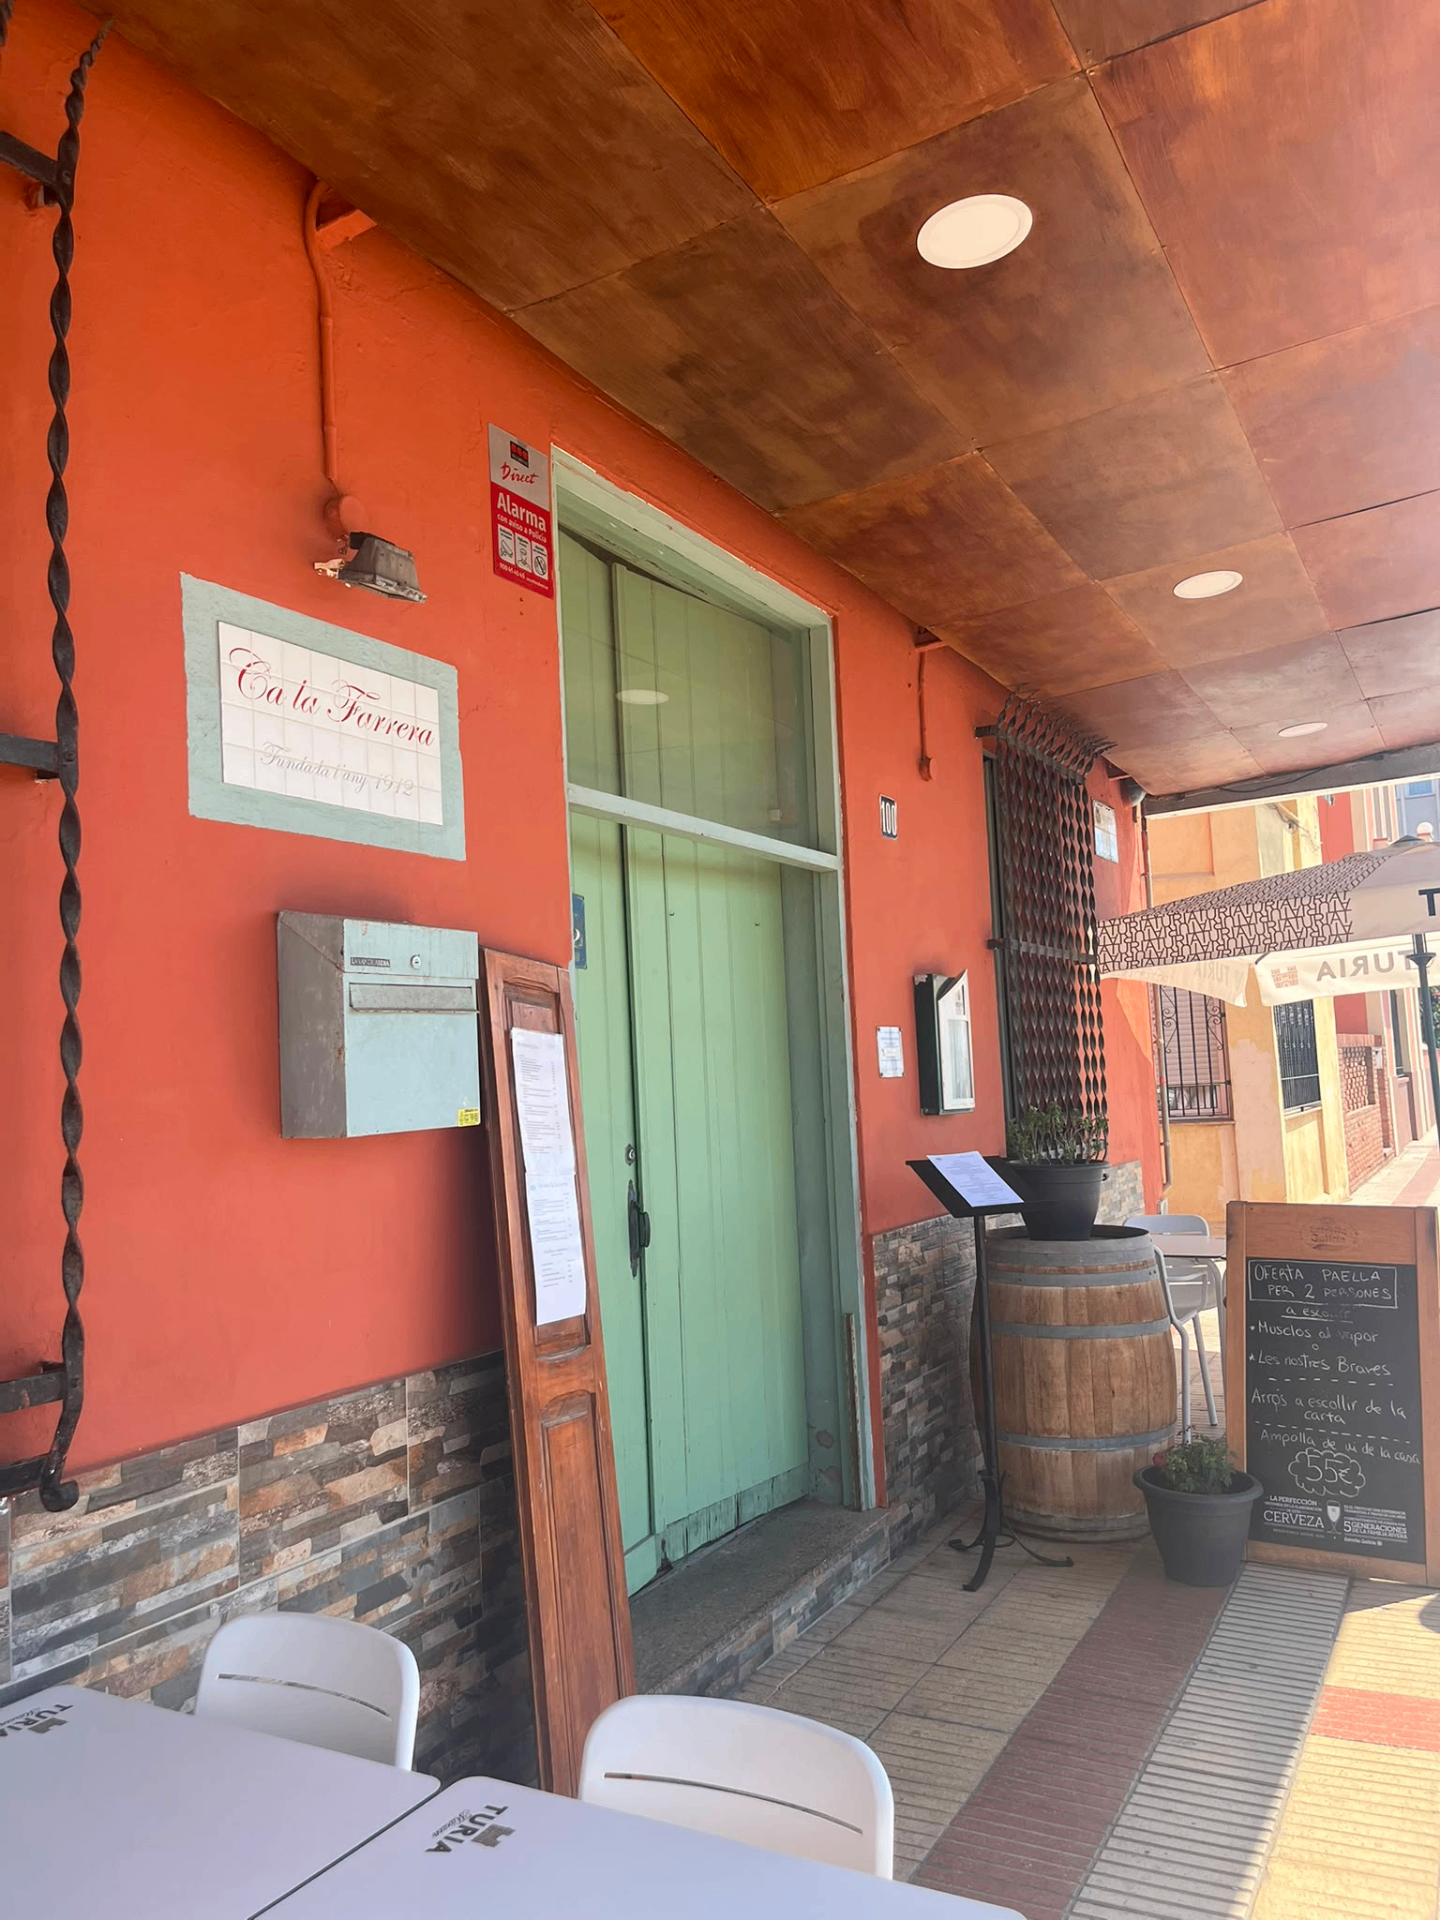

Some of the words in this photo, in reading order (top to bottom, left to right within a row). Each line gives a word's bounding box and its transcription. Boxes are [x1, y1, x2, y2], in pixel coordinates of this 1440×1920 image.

[501, 462, 540, 484] Direct
[497, 492, 546, 532] Alarma
[229, 648, 287, 706] Ca
[292, 680, 321, 714] la
[327, 679, 435, 746] Farrera
[260, 741, 331, 779] Fundada
[375, 773, 415, 797] 1912
[881, 800, 897, 837] 100
[1255, 1264, 1304, 1281] OFERTA
[1322, 1268, 1381, 1282] PAELLA
[1268, 1285, 1295, 1297] PER
[1305, 1284, 1315, 1299] 2
[1324, 1286, 1392, 1300] PERSONES
[1286, 1306, 1297, 1315] a
[1258, 1320, 1311, 1338] Musclos
[1318, 1327, 1331, 1339] al
[1258, 1350, 1280, 1365] Les
[1285, 1353, 1331, 1370] nostres
[1337, 1356, 1391, 1376] Braves
[1295, 1399, 1304, 1407] a
[1308, 1394, 1358, 1411] escollir
[1365, 1400, 1382, 1415] de
[1390, 1400, 1407, 1419] la
[1303, 1410, 1346, 1425] carta
[1260, 1429, 1316, 1447] Ampolla
[1322, 1439, 1336, 1450] de
[1361, 1442, 1374, 1456] de
[1380, 1445, 1391, 1459] la
[1394, 1453, 1421, 1465] casa
[1305, 1454, 1353, 1484] 55€
[1278, 1495, 1318, 1506] PERFECCIÓN
[1263, 1509, 1325, 1528] CERVEZA
[1343, 1520, 1352, 1532] 5
[1351, 1521, 1407, 1534] GENERACIONES
[425, 1804, 509, 1852] TURIA
